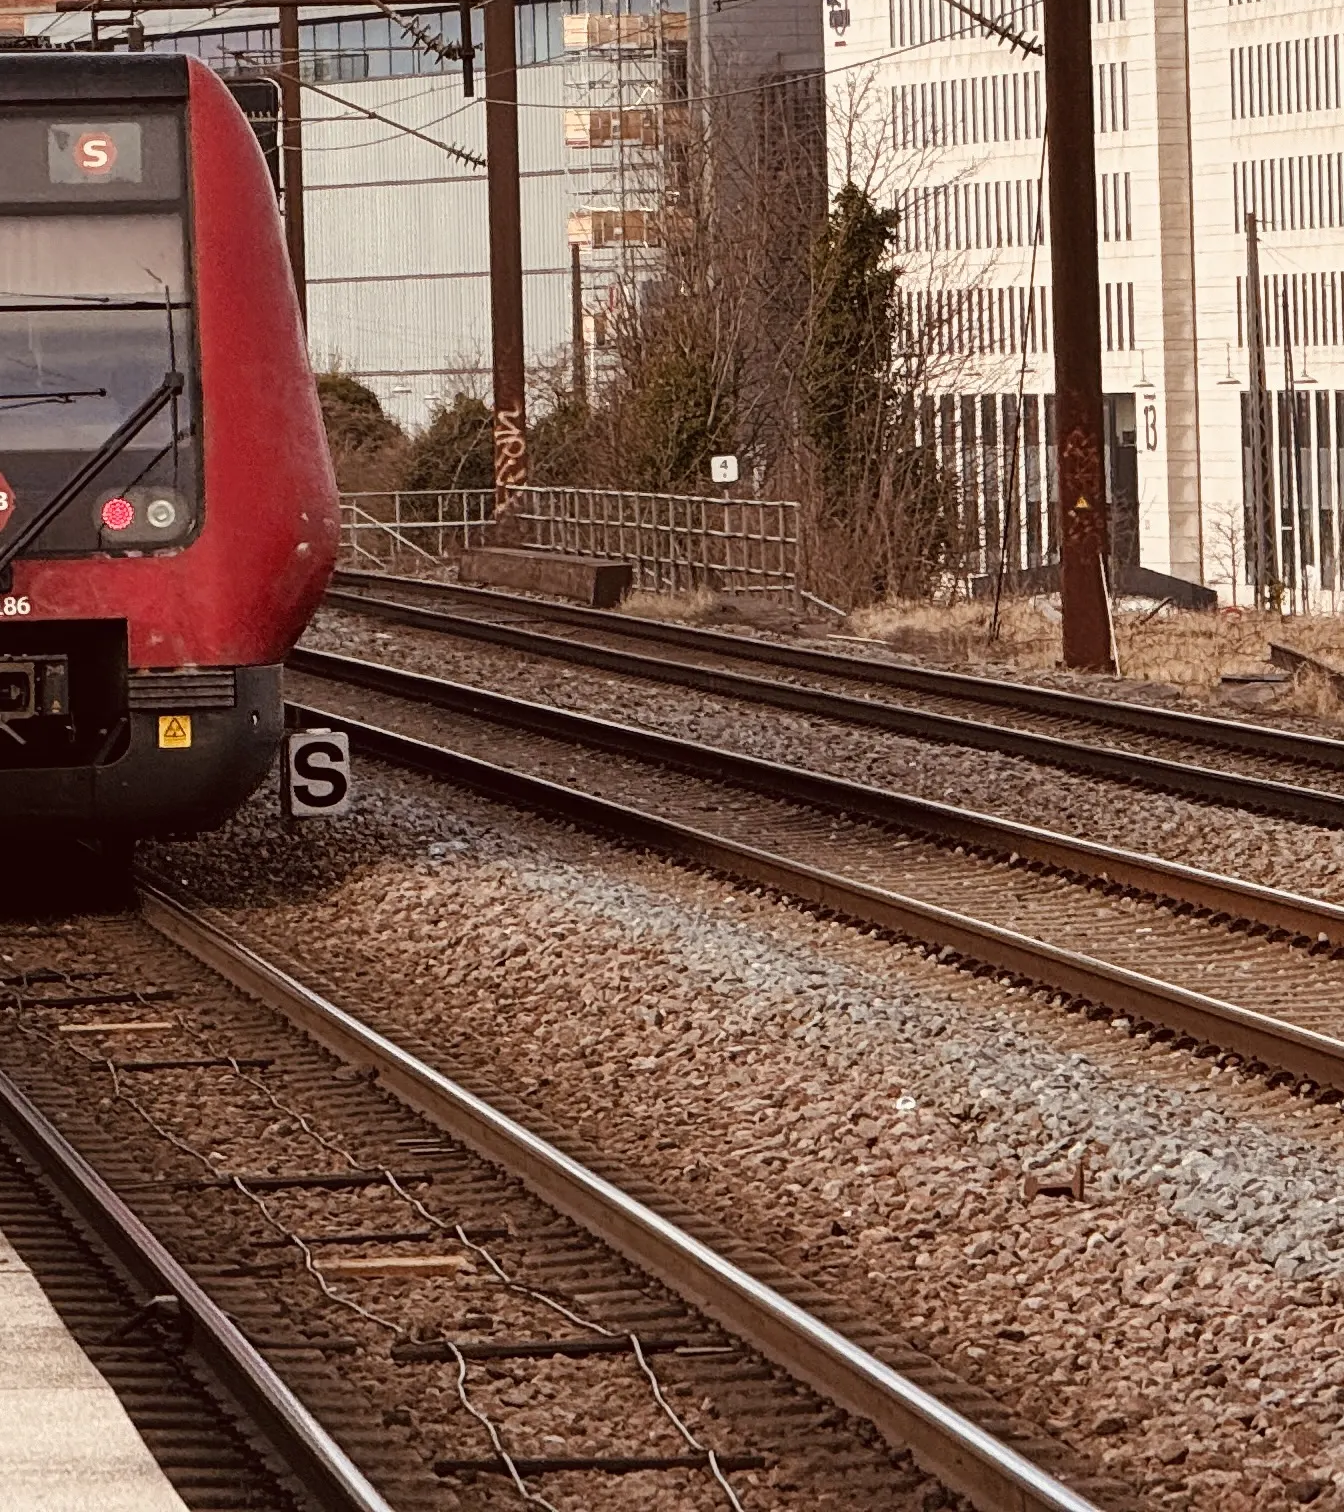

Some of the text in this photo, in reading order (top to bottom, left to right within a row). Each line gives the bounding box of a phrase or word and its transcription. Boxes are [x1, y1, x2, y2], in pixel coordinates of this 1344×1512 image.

[81, 140, 109, 168] S
[719, 459, 729, 470] 4
[293, 741, 348, 808] S
